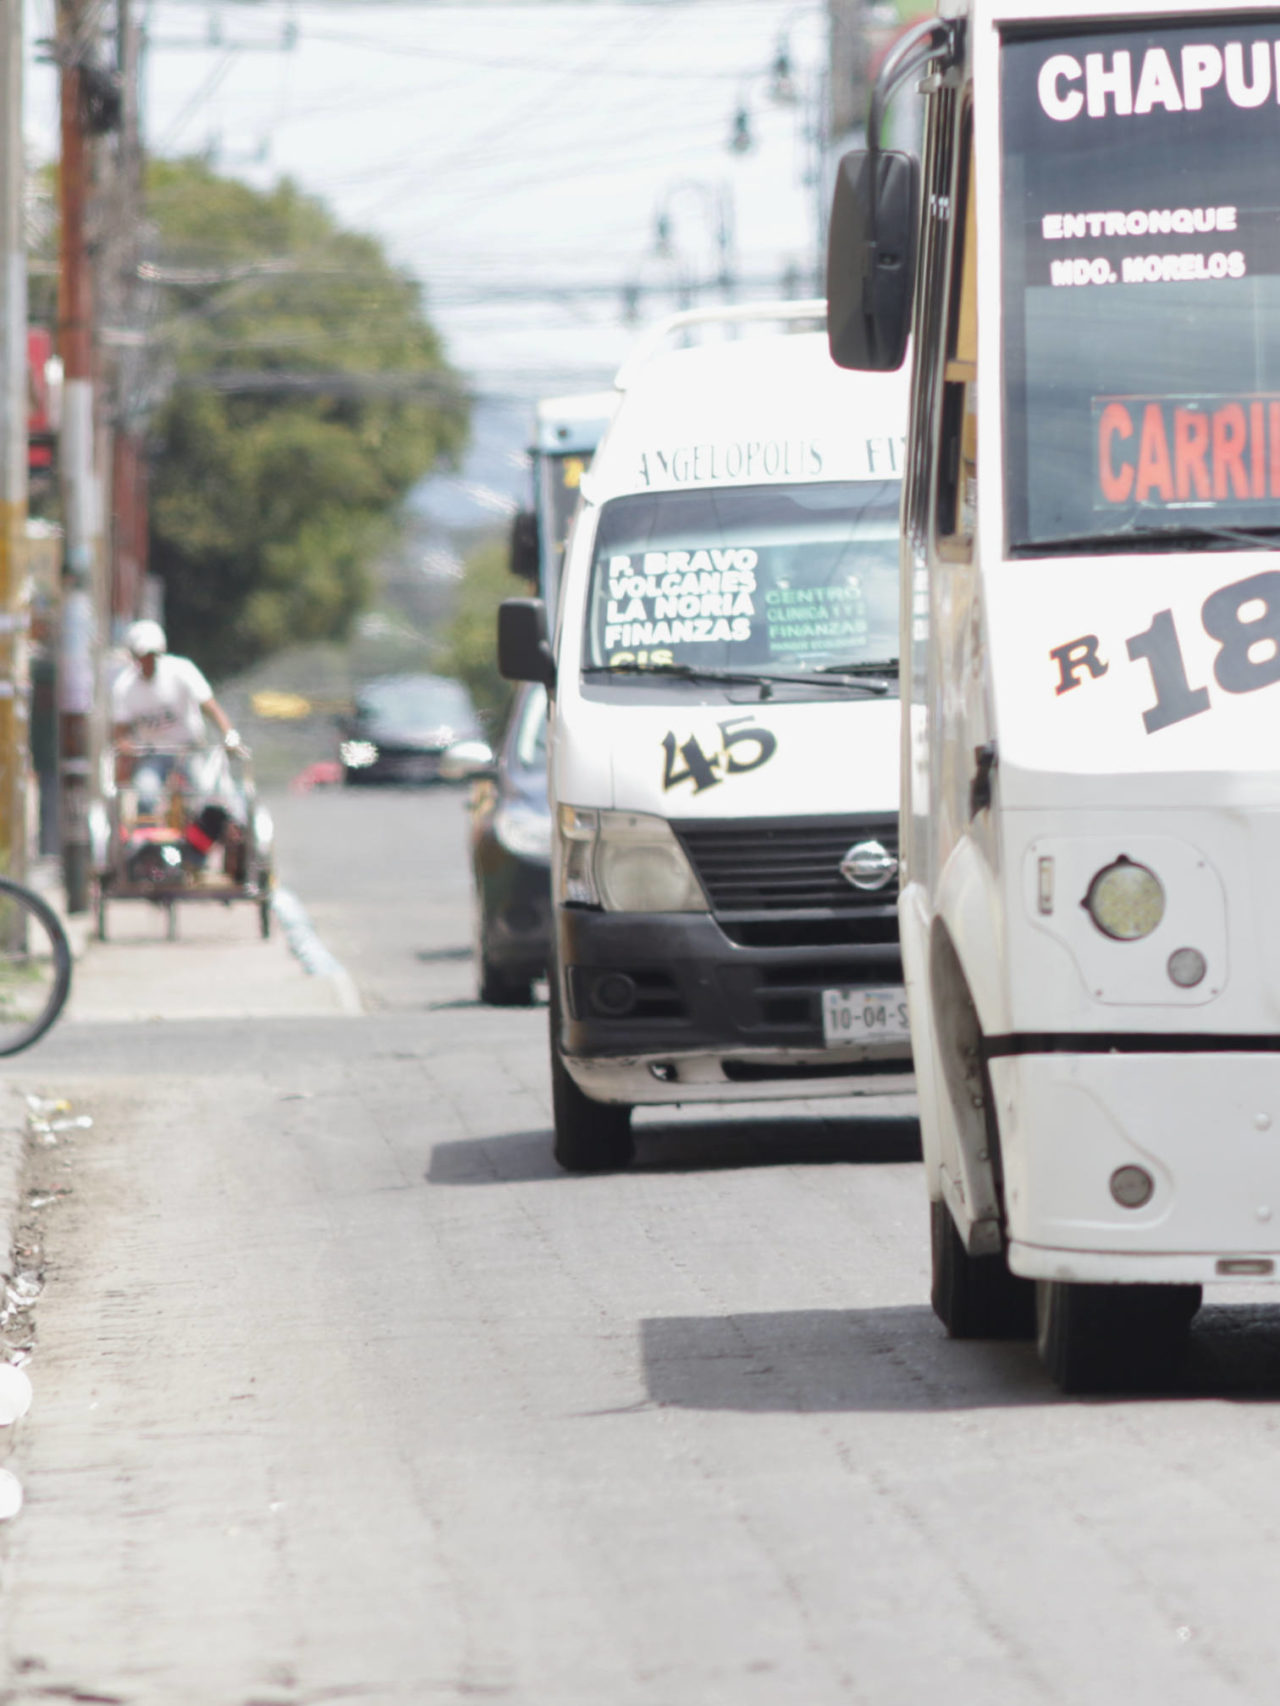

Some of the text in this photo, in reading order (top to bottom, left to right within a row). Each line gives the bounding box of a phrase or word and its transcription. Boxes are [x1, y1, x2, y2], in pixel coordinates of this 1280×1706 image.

[1042, 206, 1237, 239] ENTRONQUE
[1050, 251, 1246, 287] MDO. MORELOS
[643, 548, 758, 576] BRAVO
[608, 571, 757, 600] VOLCANES
[606, 591, 755, 624] LA NORIA
[604, 616, 751, 649] FINANZAS
[1049, 634, 1109, 696] R
[660, 715, 778, 795] 45
